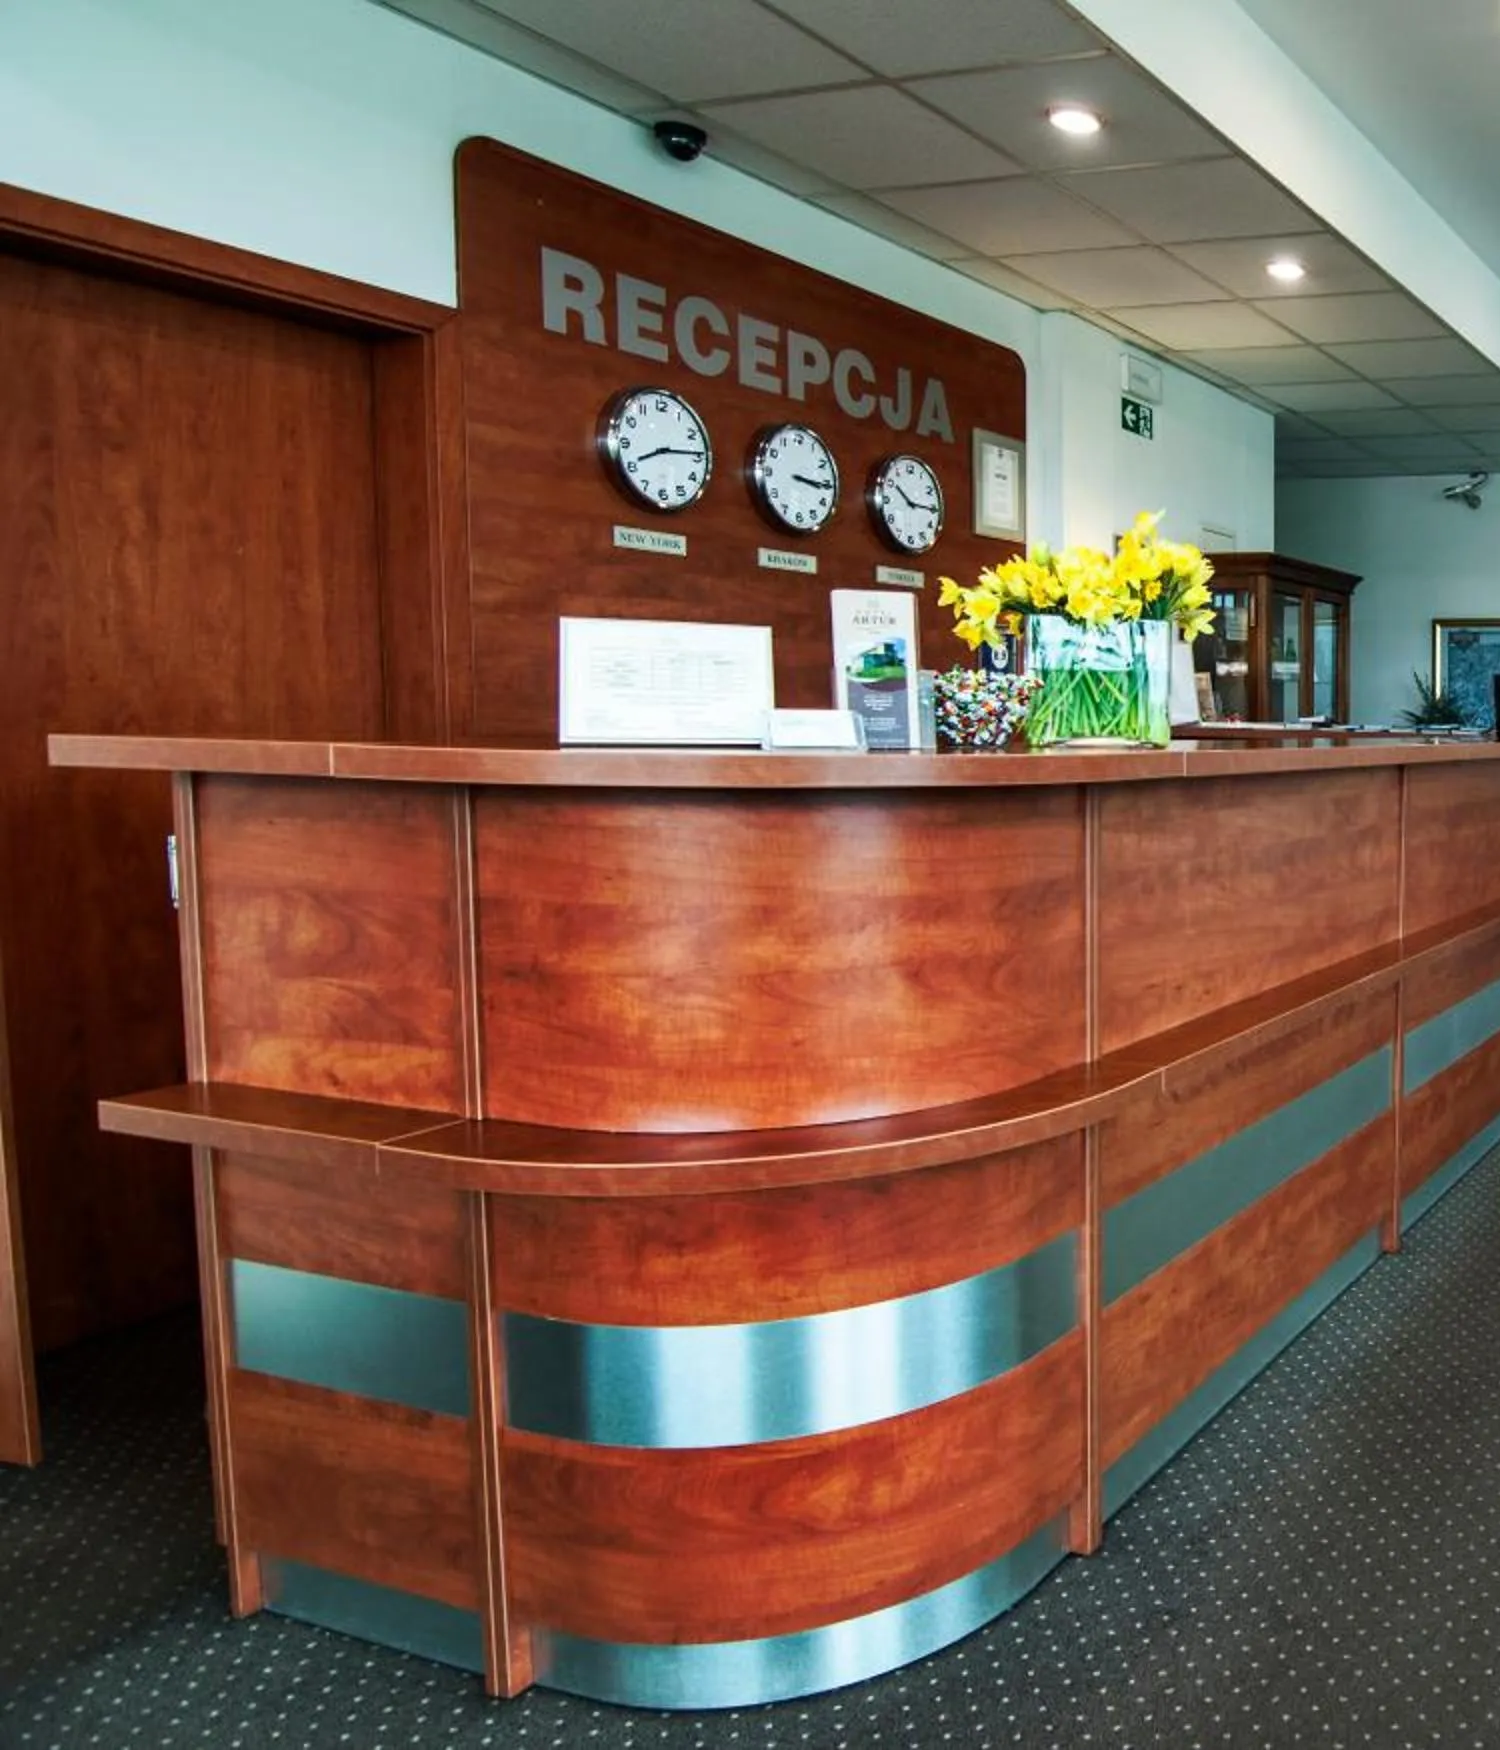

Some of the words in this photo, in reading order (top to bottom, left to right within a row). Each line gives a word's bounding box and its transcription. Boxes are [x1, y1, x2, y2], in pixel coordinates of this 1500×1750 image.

[541, 246, 955, 444] RECEPCJA
[639, 404, 647, 416] 11
[655, 399, 668, 413] 12
[688, 428, 697, 440] 2
[620, 437, 630, 449] 9
[627, 461, 637, 473] 8
[688, 471, 697, 482] 4
[640, 479, 649, 492] 7
[676, 485, 687, 497] 5
[658, 488, 669, 501] 6
[619, 531, 646, 545] NEW
